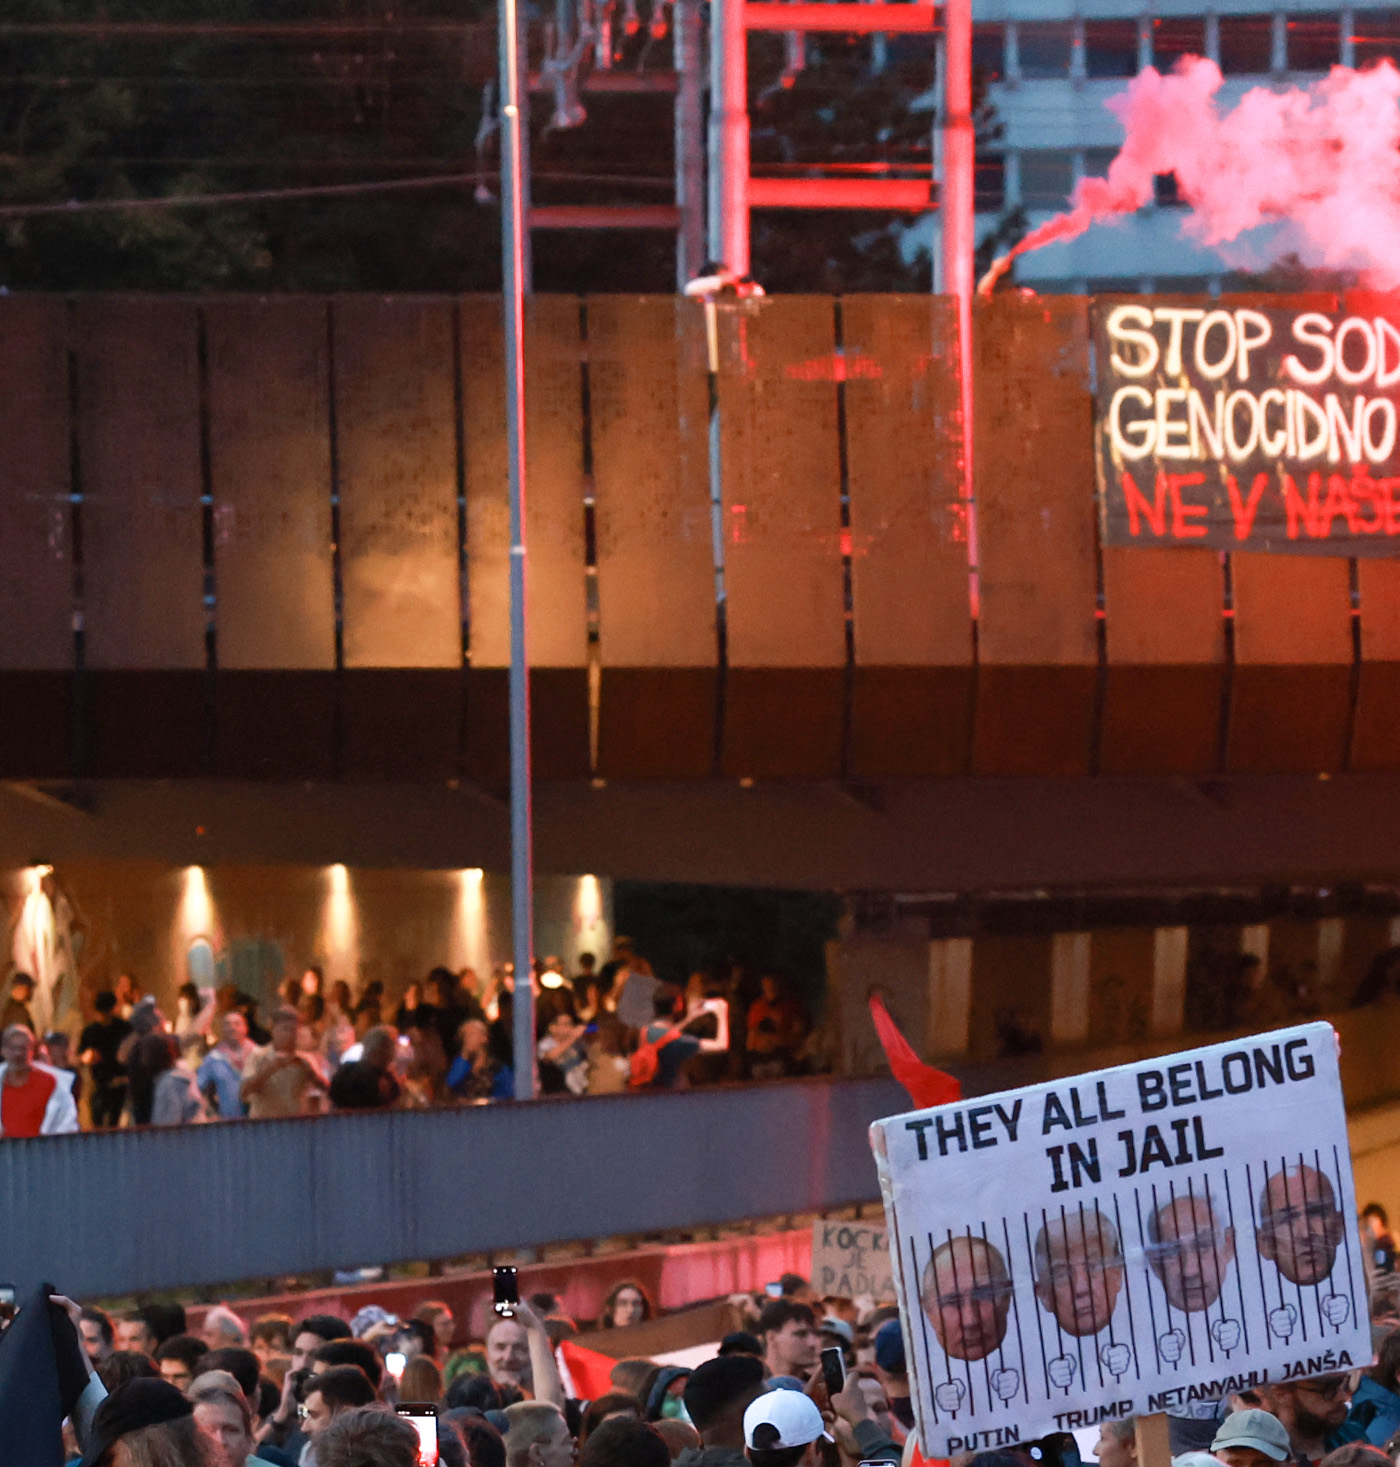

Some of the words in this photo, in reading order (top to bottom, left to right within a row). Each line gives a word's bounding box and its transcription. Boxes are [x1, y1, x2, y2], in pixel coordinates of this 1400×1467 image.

[1106, 304, 1273, 382] STOP
[1110, 385, 1398, 464] GENOCIDNO
[1121, 470, 1209, 539] NE
[1225, 472, 1270, 541] V
[905, 1098, 1023, 1161] THEY
[1041, 1080, 1126, 1136] ALL
[1135, 1037, 1317, 1114] BELONG
[1045, 1136, 1102, 1193] IN
[1117, 1114, 1225, 1178] JAIL
[821, 1223, 889, 1252] KOCK
[946, 1423, 1021, 1457] PUTIN
[1052, 1399, 1136, 1432] TRUMP
[1147, 1368, 1269, 1412] NETANYAHU
[1281, 1349, 1354, 1381] JANŠA
